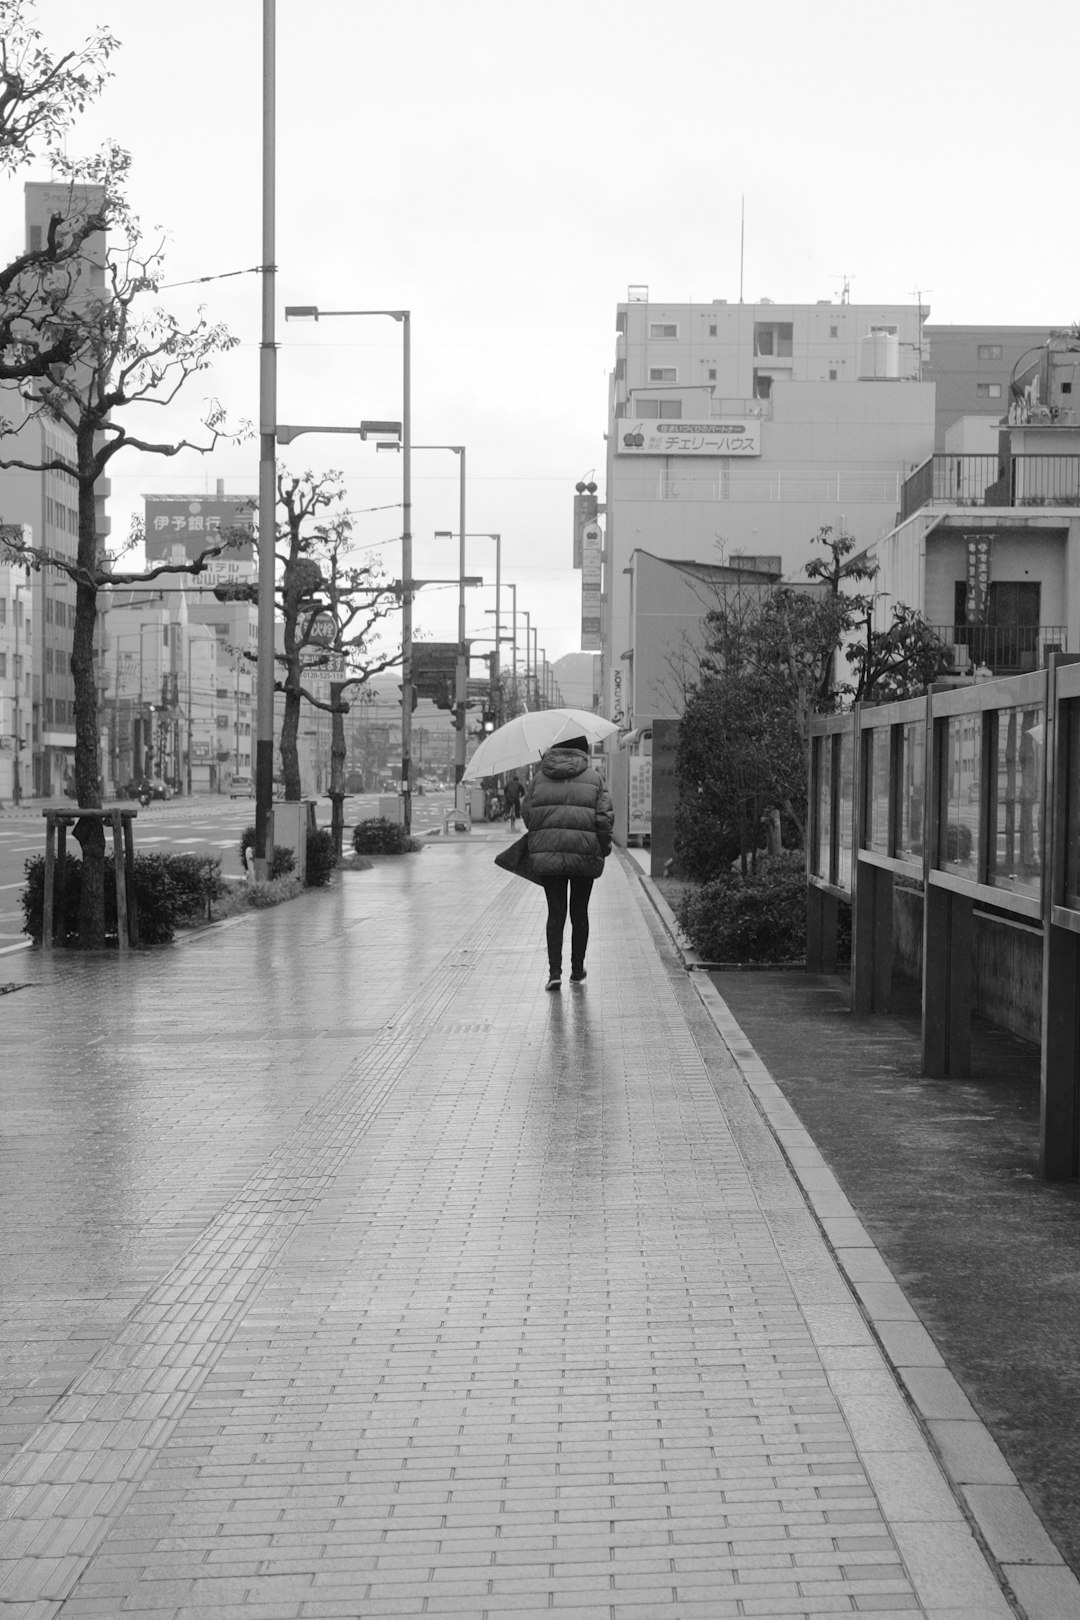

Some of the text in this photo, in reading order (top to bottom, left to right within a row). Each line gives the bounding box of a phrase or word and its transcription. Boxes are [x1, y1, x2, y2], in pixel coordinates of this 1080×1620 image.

[665, 437, 754, 450] チェリーハウス
[153, 515, 221, 531] 伊予銀行
